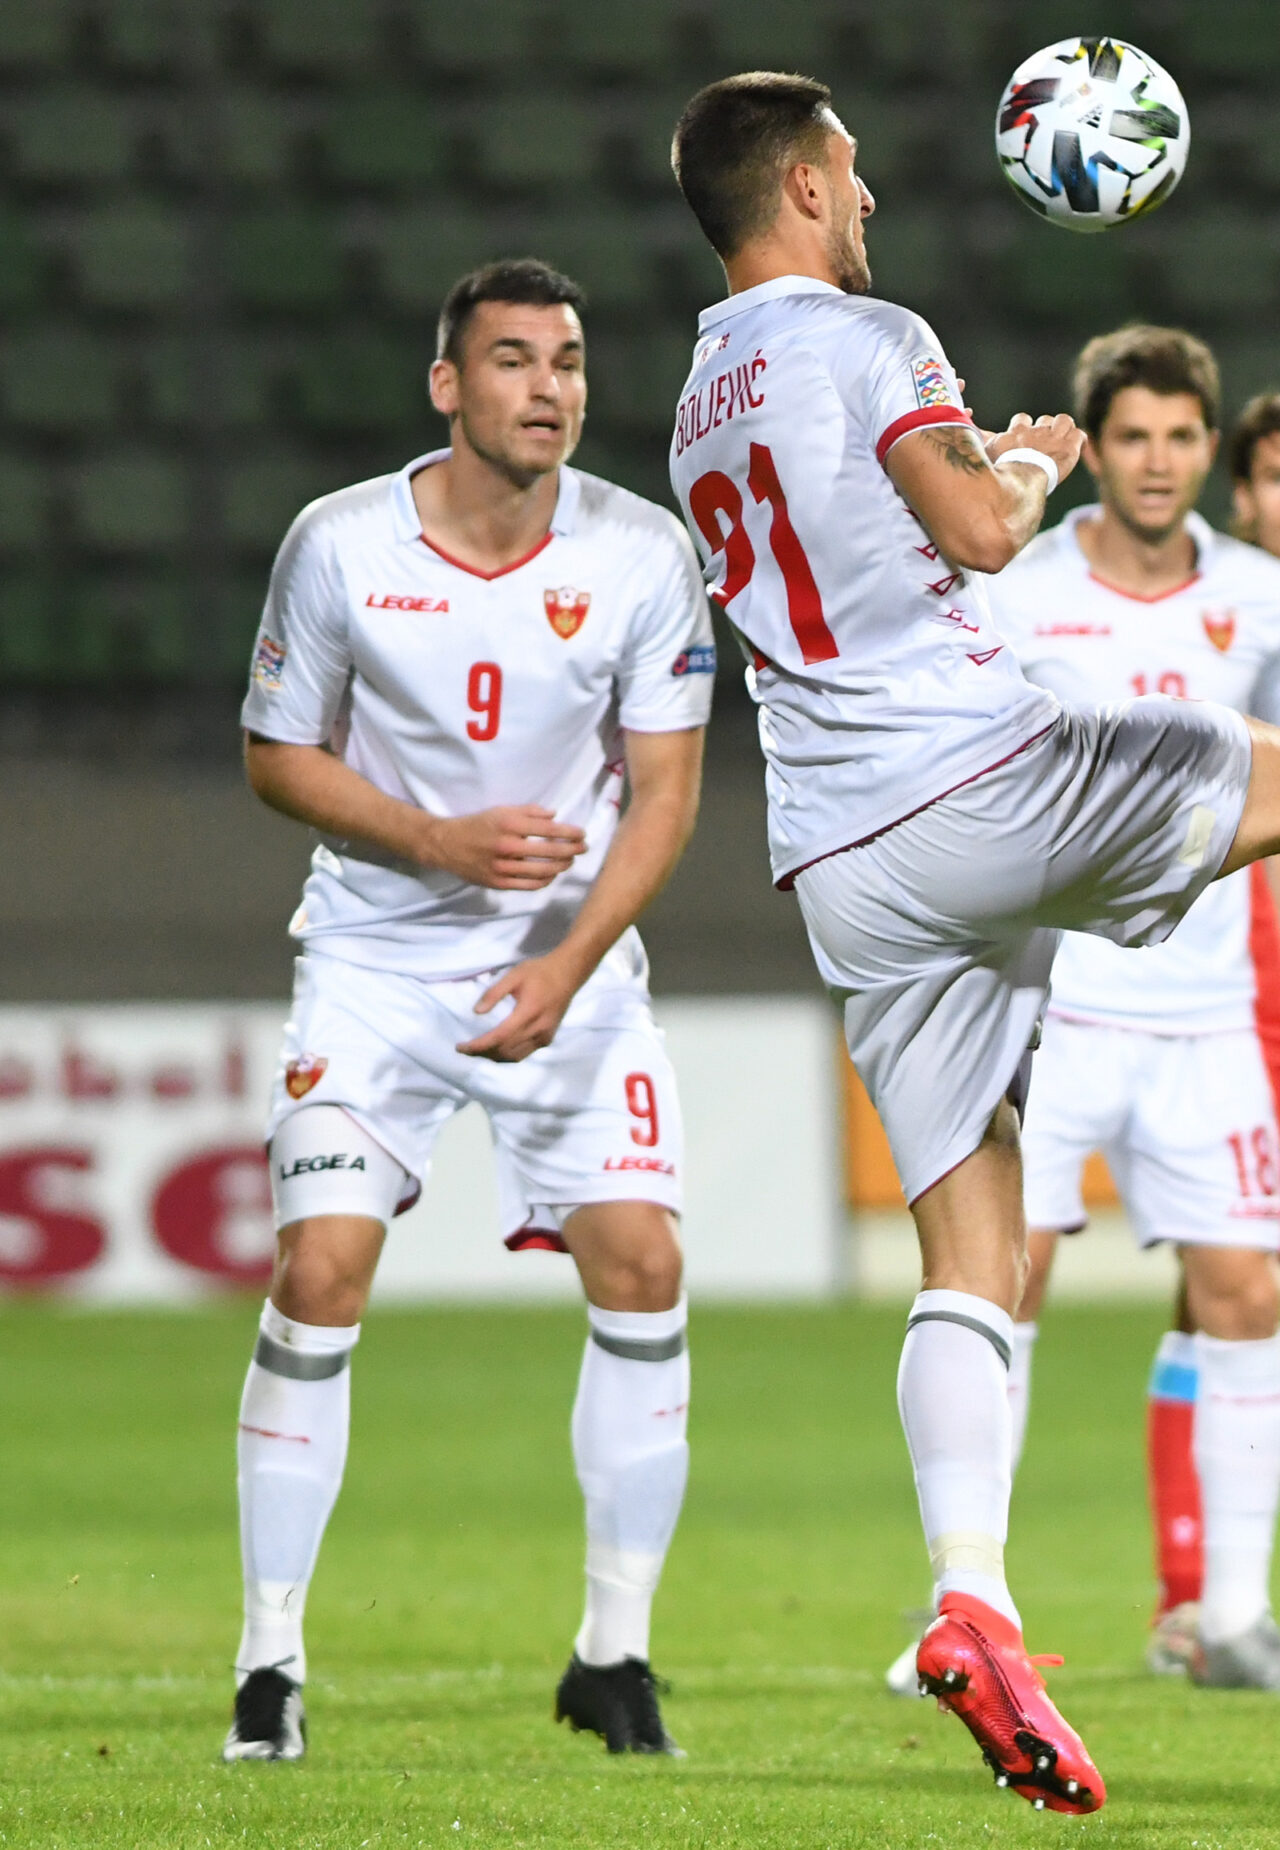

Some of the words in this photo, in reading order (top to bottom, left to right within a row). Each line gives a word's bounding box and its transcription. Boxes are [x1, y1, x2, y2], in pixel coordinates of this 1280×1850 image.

[676, 348, 767, 457] BOLJEVIĆ
[689, 442, 841, 671] 21
[366, 592, 450, 613] LEGEA
[466, 661, 503, 742] 9
[624, 1071, 659, 1147] 9
[280, 1153, 366, 1181] LEGEA
[602, 1155, 676, 1177] LEGEA
